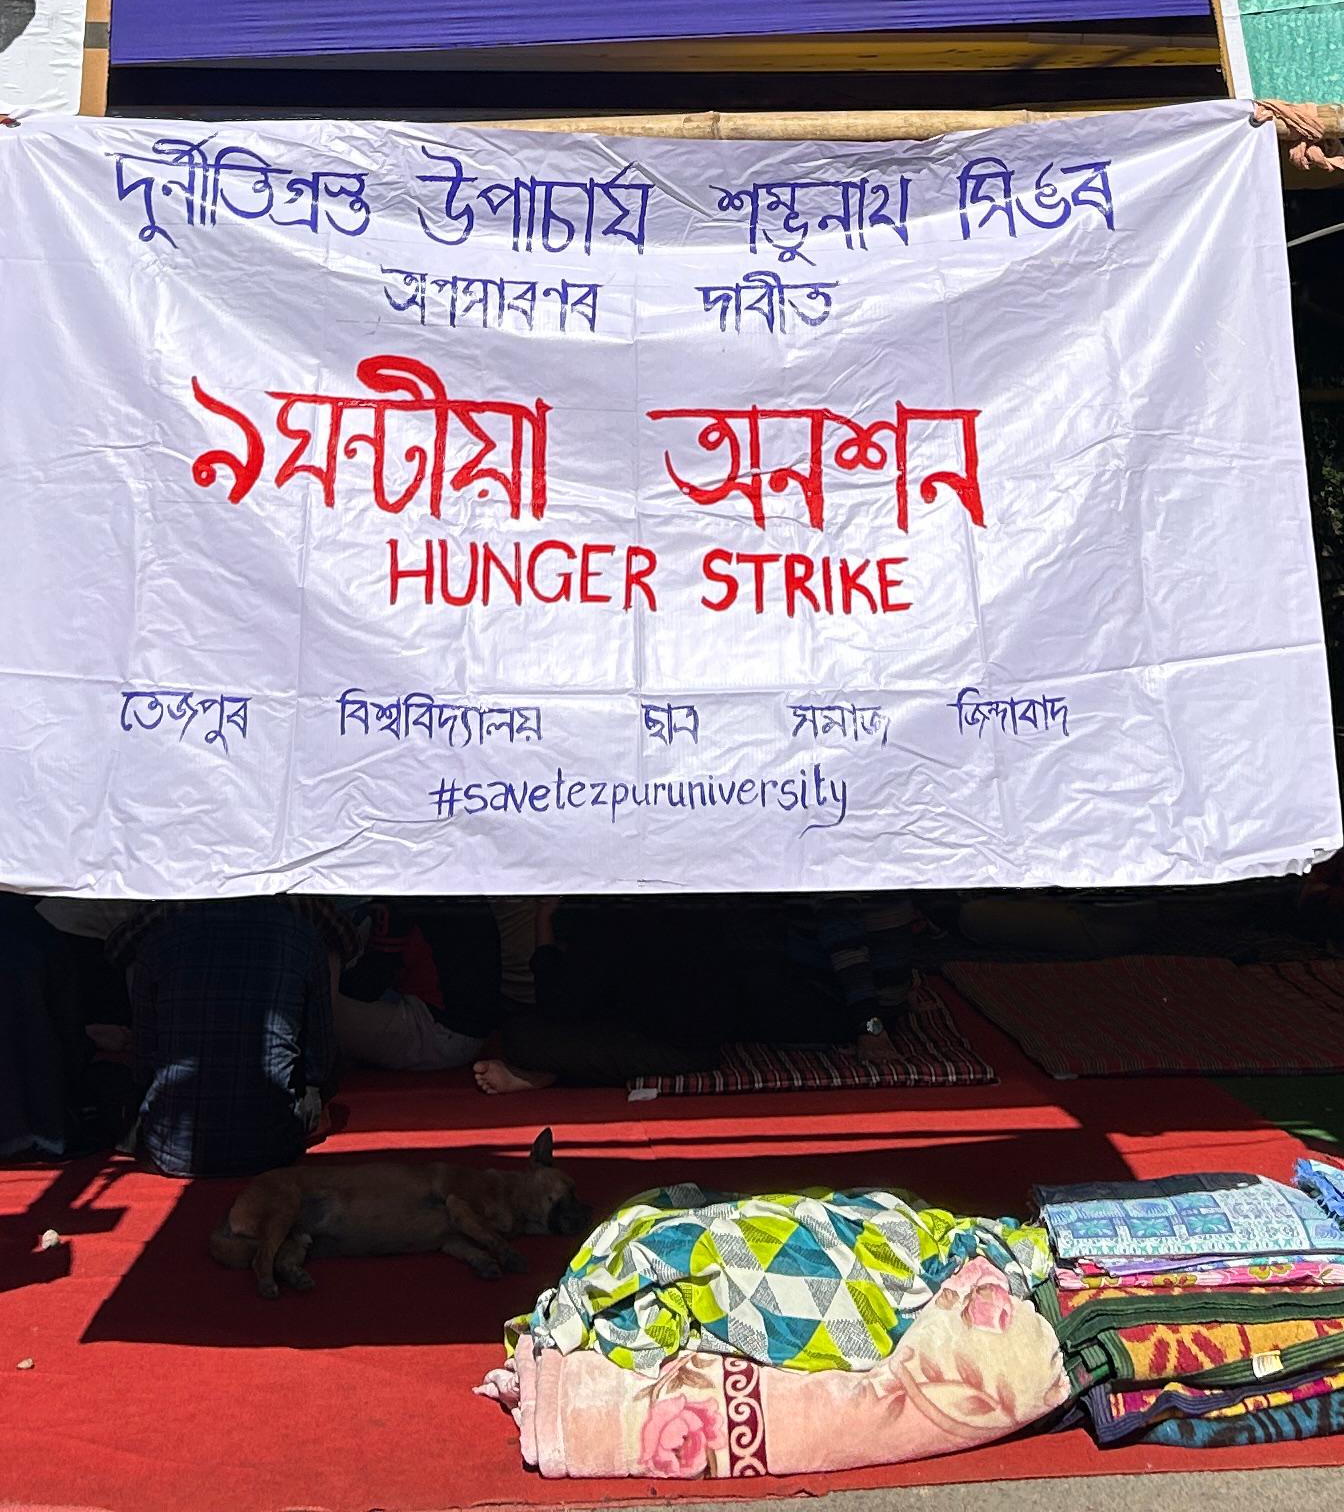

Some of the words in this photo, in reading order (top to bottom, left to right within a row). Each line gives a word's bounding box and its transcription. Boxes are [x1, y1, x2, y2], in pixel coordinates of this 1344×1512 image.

[645, 399, 988, 534] অনশন
[384, 538, 658, 612] HUNGER
[701, 548, 915, 618] STRIKE
[427, 763, 848, 840] #savetezpuruniversity
